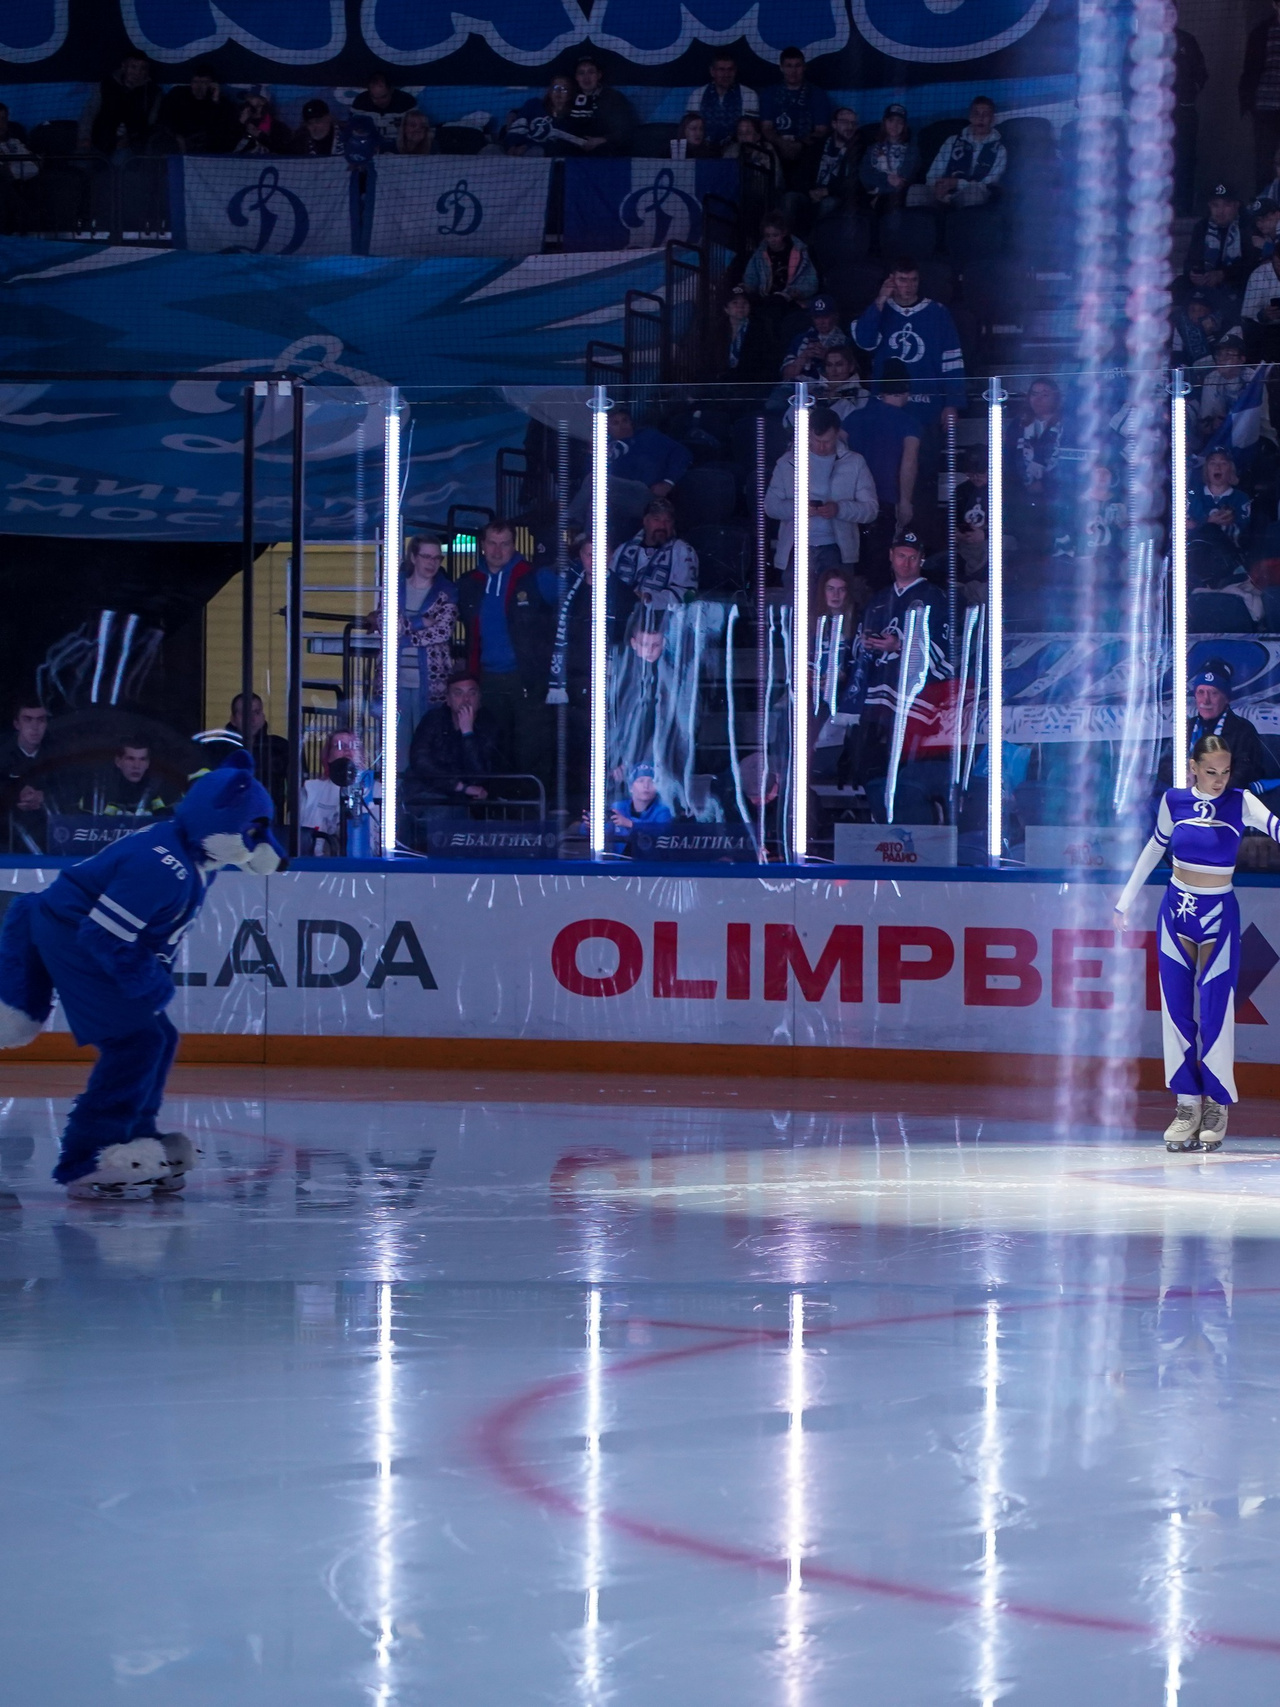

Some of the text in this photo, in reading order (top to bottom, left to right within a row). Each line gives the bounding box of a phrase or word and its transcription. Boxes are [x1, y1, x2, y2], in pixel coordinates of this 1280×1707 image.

[465, 833, 543, 847] БАЛТИКА
[669, 835, 745, 849] БАЛТИКА
[874, 842, 903, 853] АВТО
[882, 852, 917, 863] РАДИО
[172, 919, 438, 990] ADA
